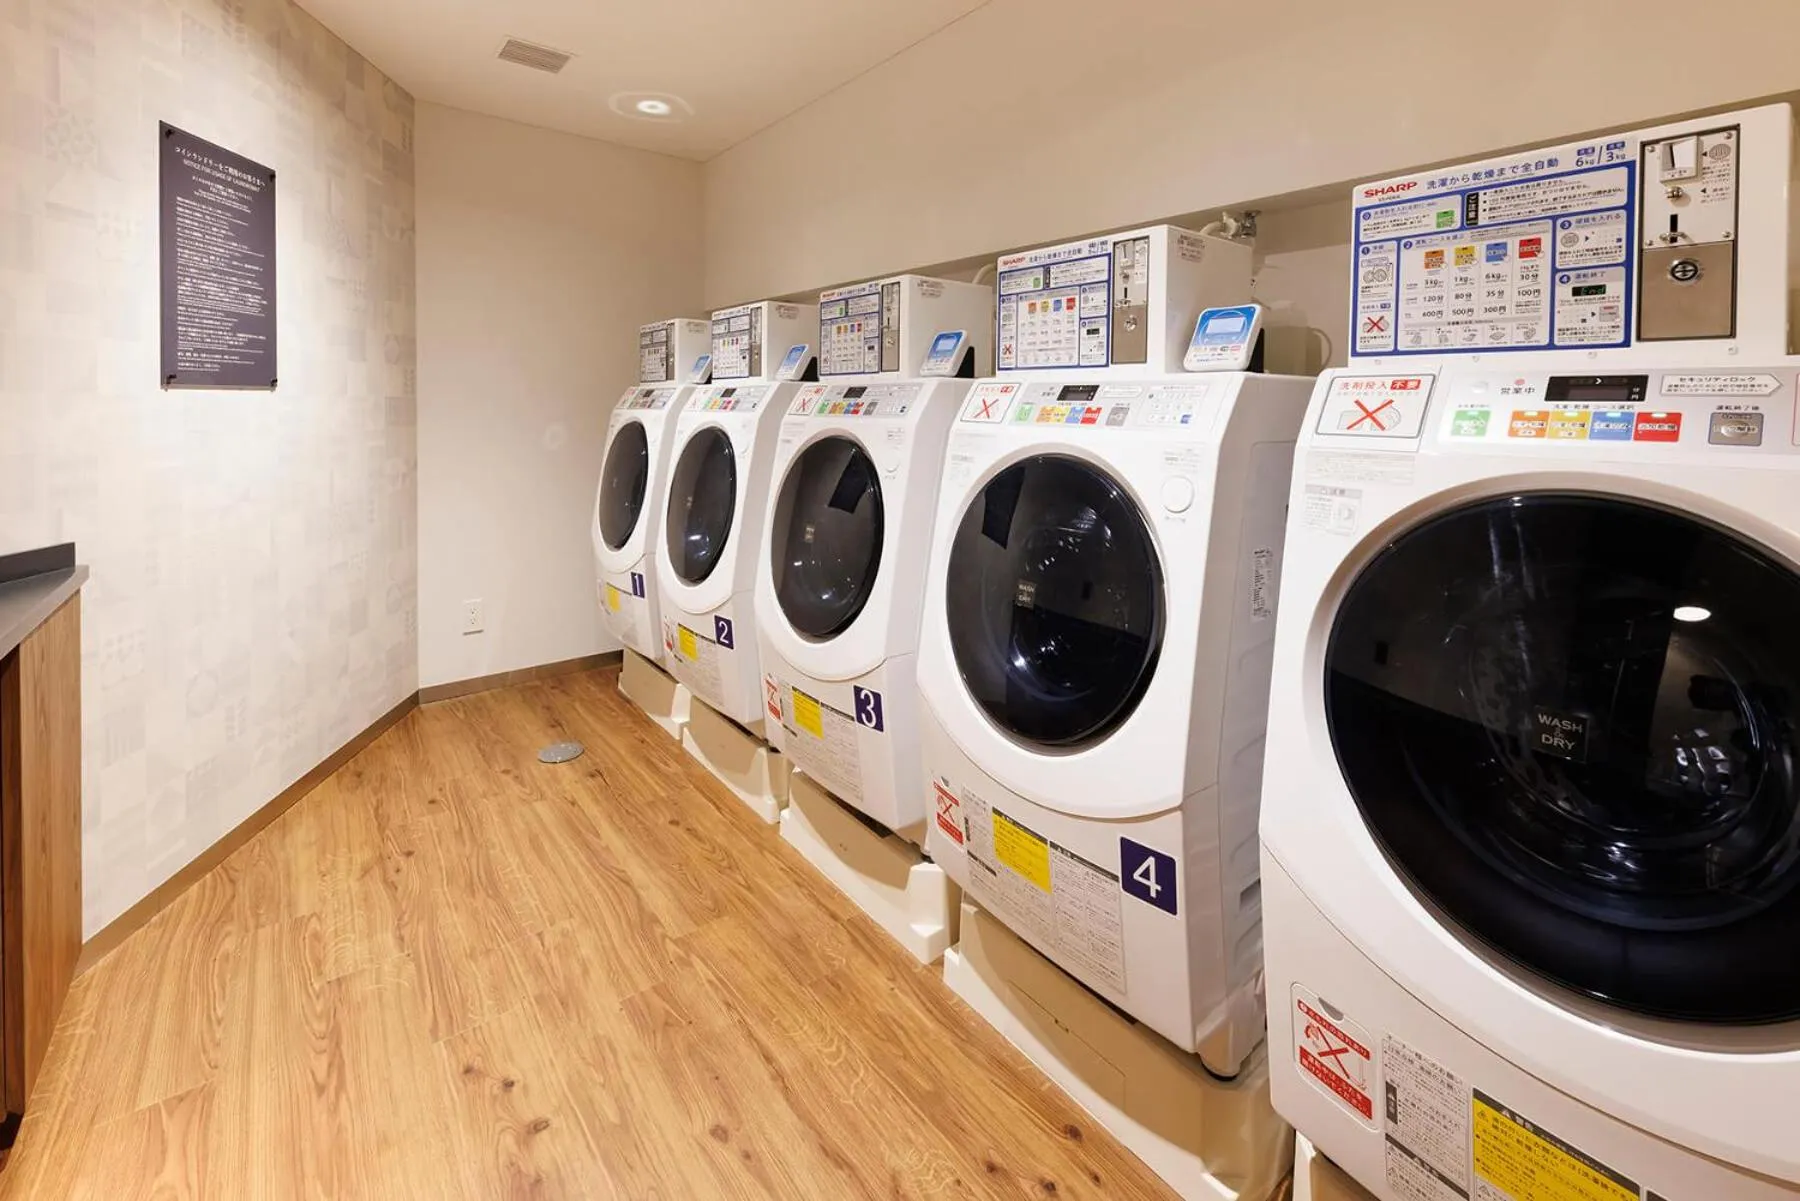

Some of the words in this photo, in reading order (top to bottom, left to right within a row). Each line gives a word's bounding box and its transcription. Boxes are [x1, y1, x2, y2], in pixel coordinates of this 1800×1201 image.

[1427, 158, 1559, 190] 洗濯から乾燥まで全自動
[1364, 181, 1418, 198] SHARP
[1340, 381, 1388, 390] 洗剤投入
[1392, 379, 1421, 390] 不要
[1501, 386, 1536, 395] 営業中
[718, 620, 730, 645] 2
[861, 689, 876, 729] 3
[1538, 713, 1583, 733] WASH
[1541, 733, 1576, 750] DRY
[1132, 855, 1162, 899] 4
